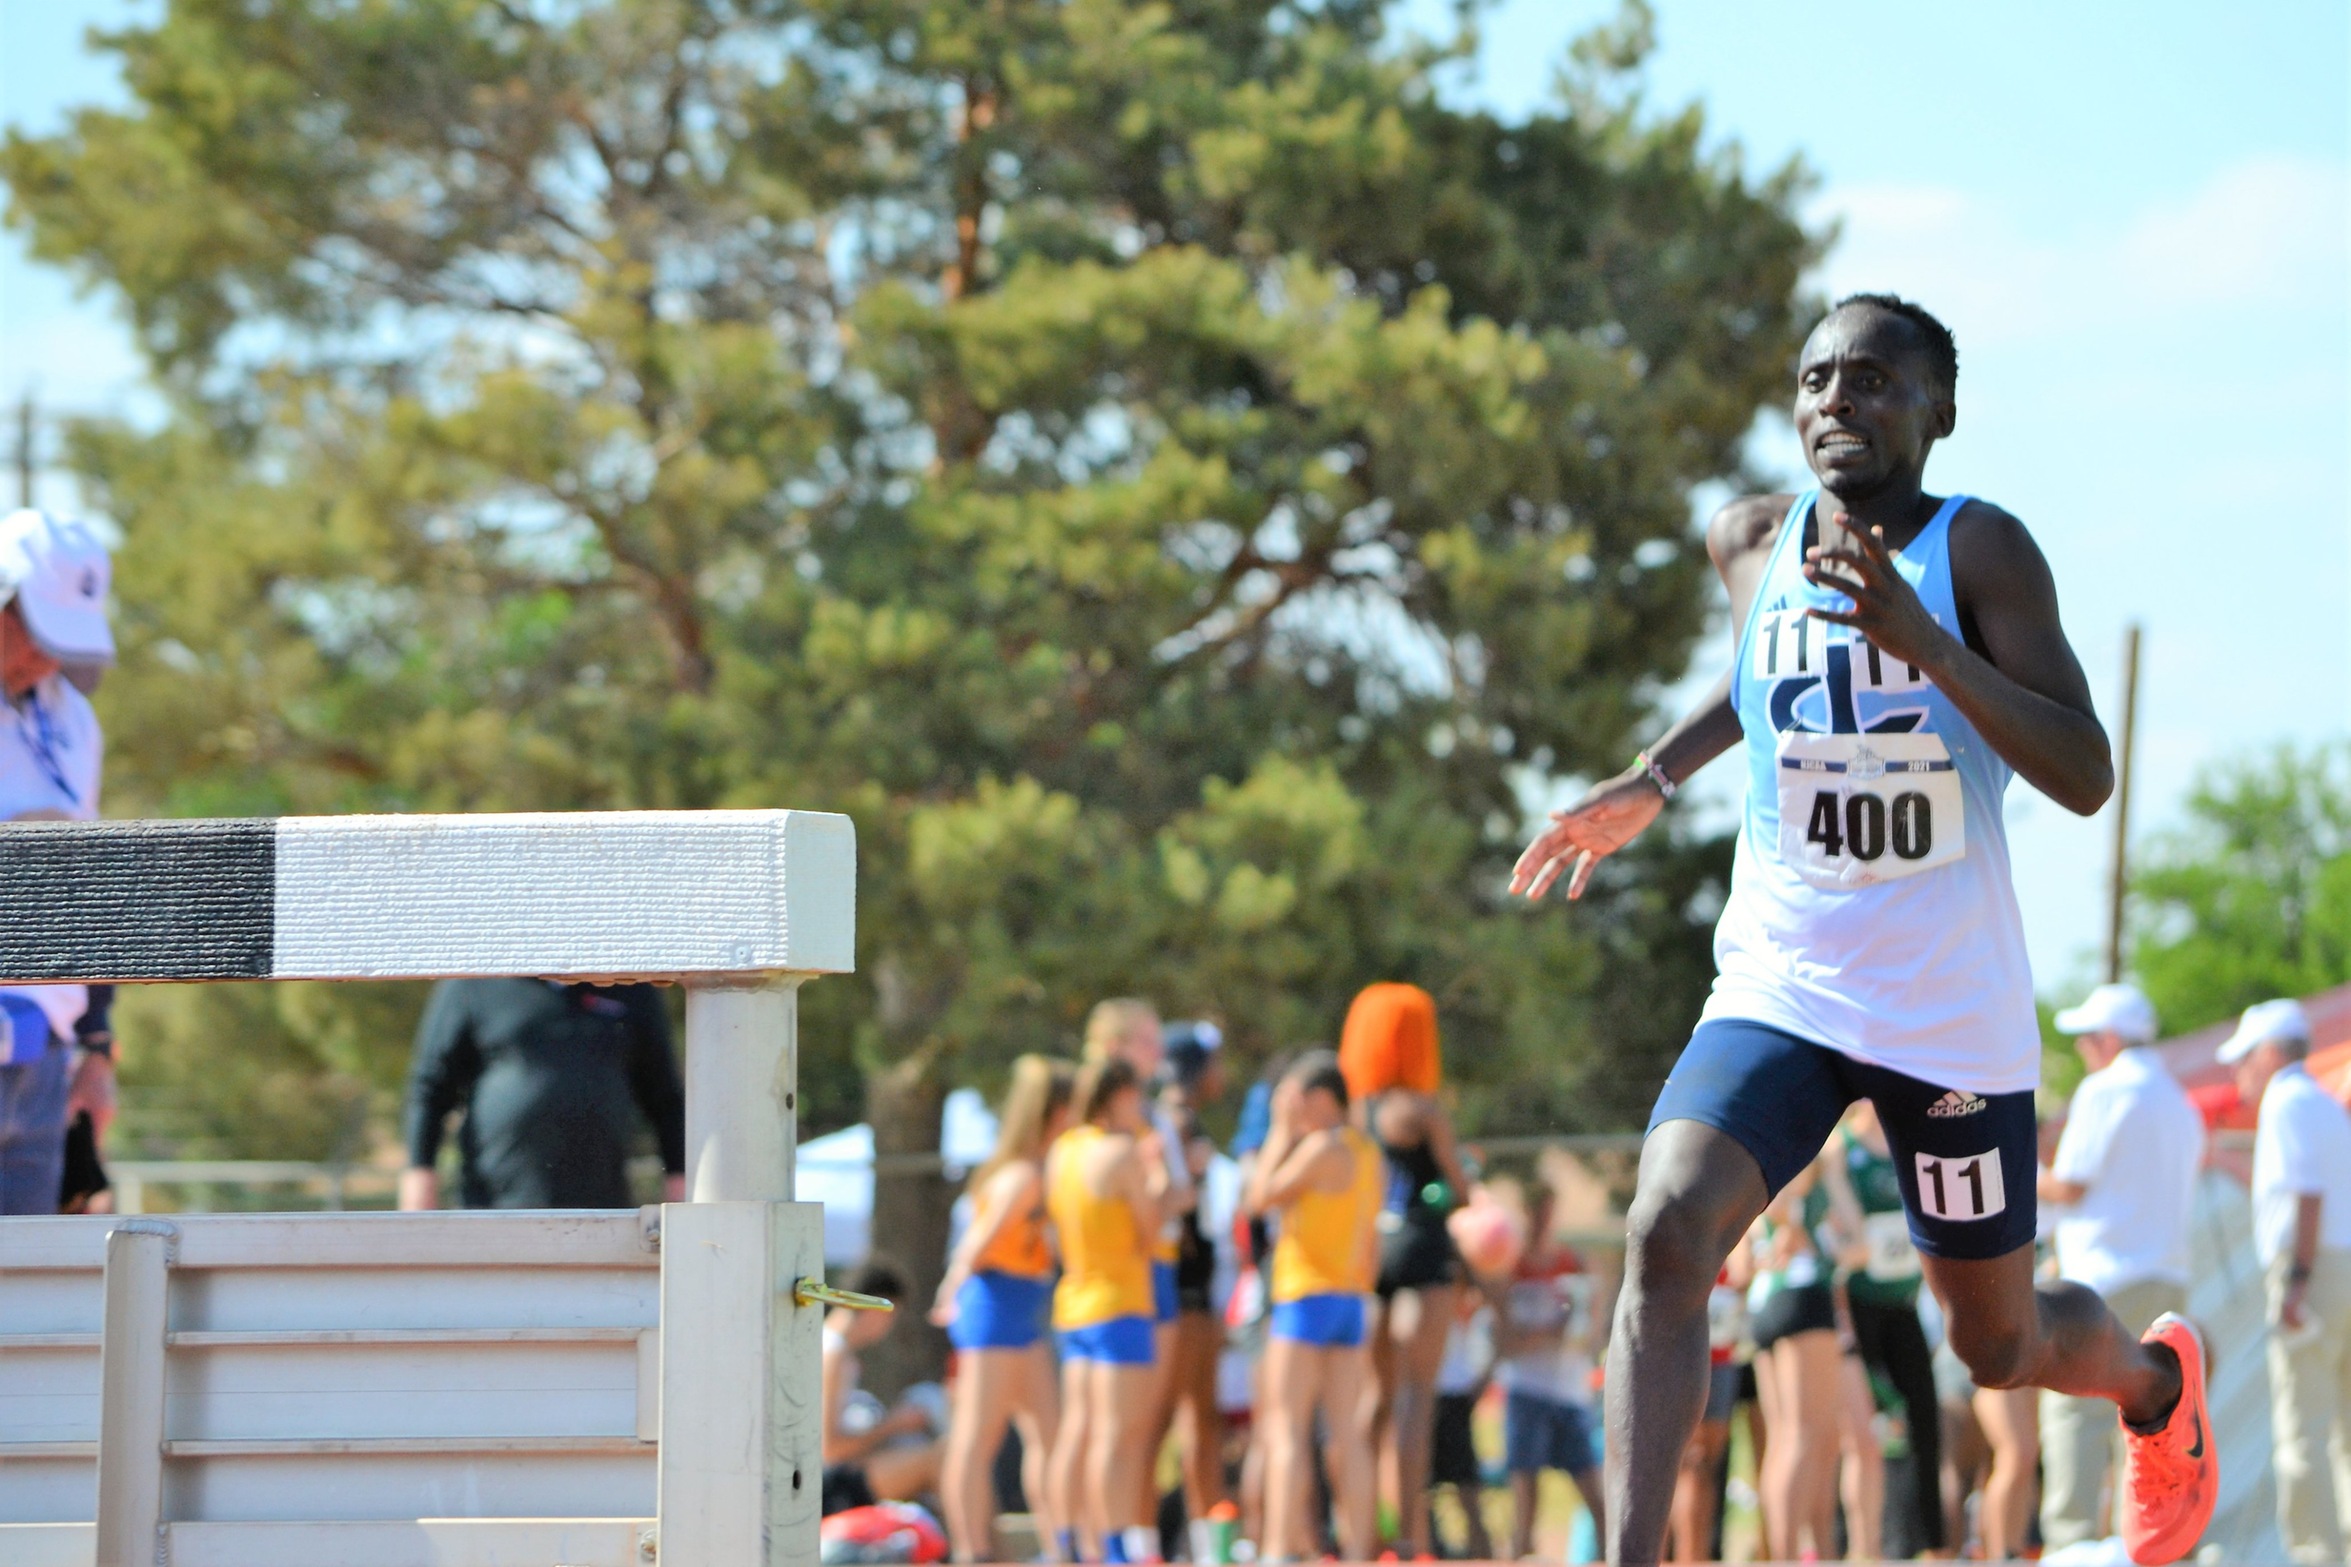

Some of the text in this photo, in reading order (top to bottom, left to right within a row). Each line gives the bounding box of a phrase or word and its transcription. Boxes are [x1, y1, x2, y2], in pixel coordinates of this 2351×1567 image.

[1764, 613, 1809, 675] 11
[1908, 760, 1930, 772] 2021
[1807, 790, 1933, 861] 400
[1927, 1099, 1986, 1118] adidas
[1923, 1159, 1984, 1215] 11
